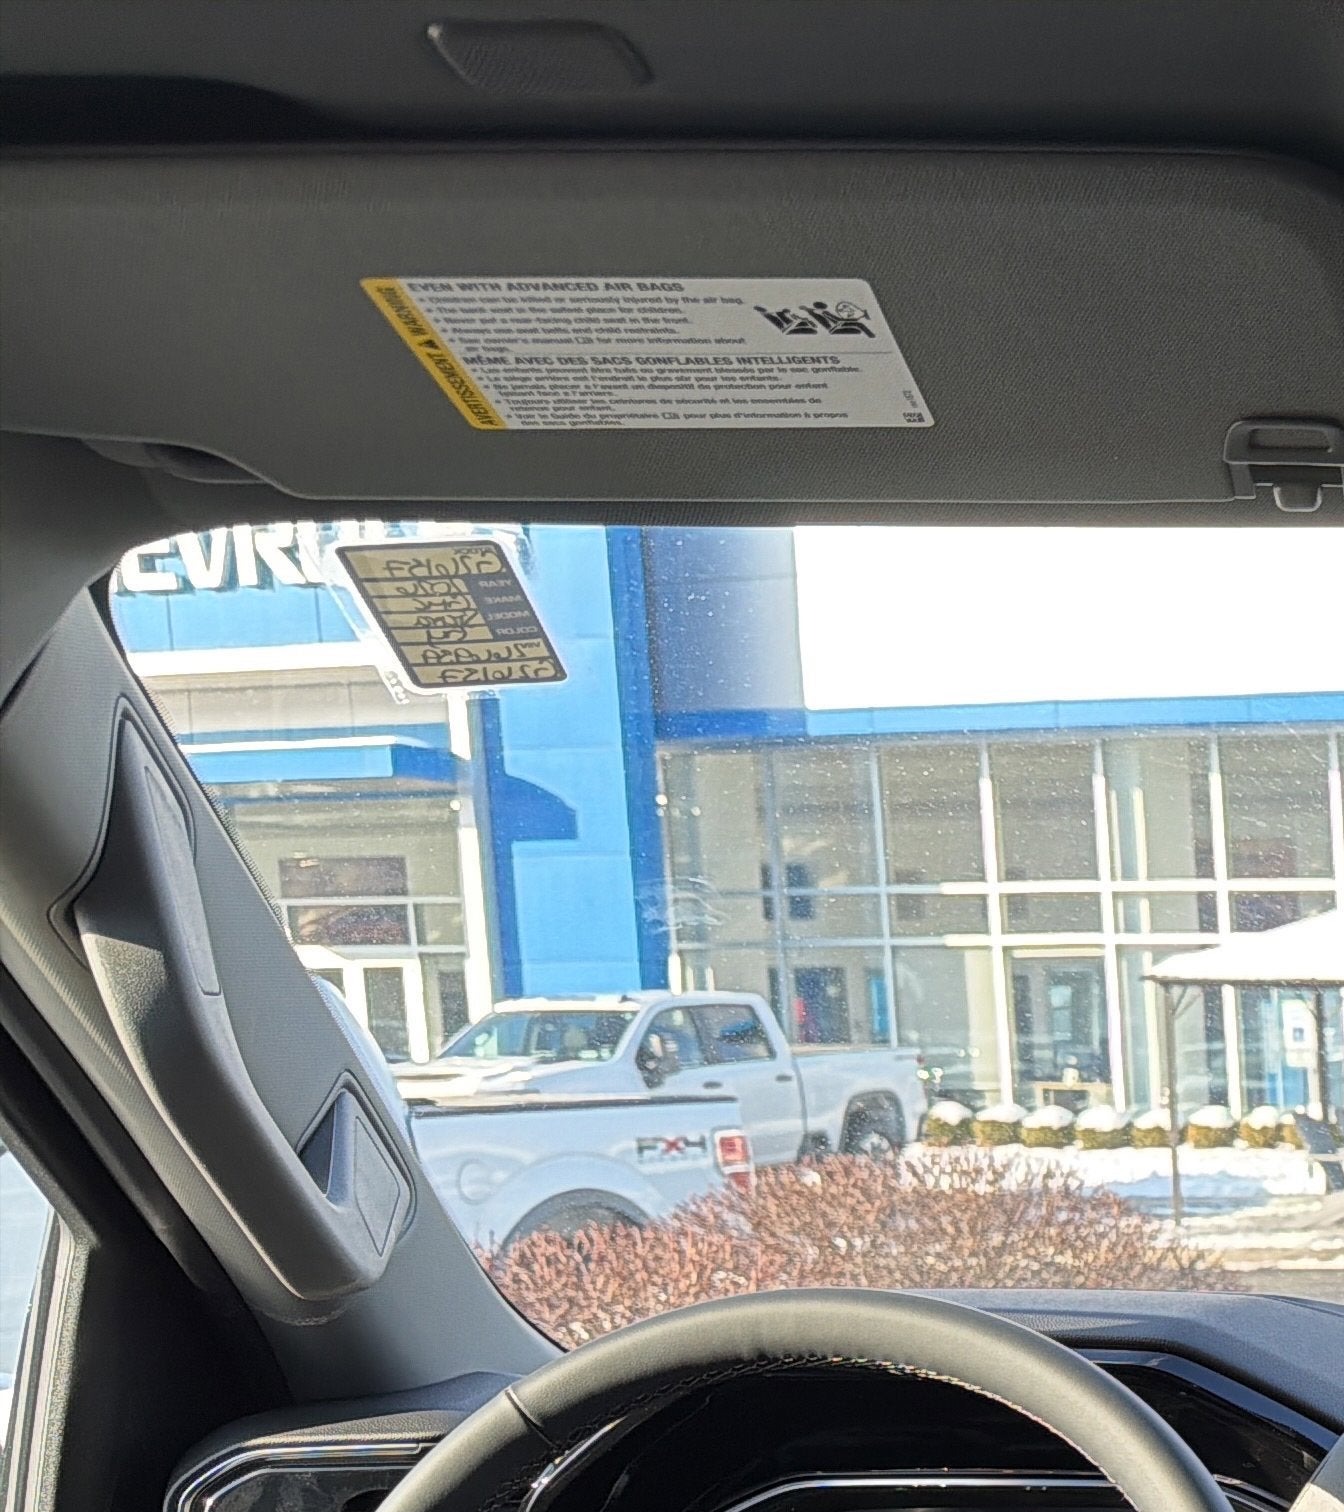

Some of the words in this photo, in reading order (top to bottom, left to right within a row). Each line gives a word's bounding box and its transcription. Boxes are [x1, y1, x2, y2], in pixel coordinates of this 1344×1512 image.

[407, 283, 453, 292] EVEN
[457, 283, 502, 292] WITH
[506, 283, 599, 292] ADVANCED
[603, 283, 632, 292] AIR
[637, 283, 685, 292] BAGS
[515, 356, 553, 366] AVEC
[557, 356, 588, 366] DES
[591, 356, 632, 366] SACS
[635, 356, 734, 366] GONFLABLES
[737, 356, 840, 366] INTELLIGENTS
[637, 1136, 707, 1159] FX4
